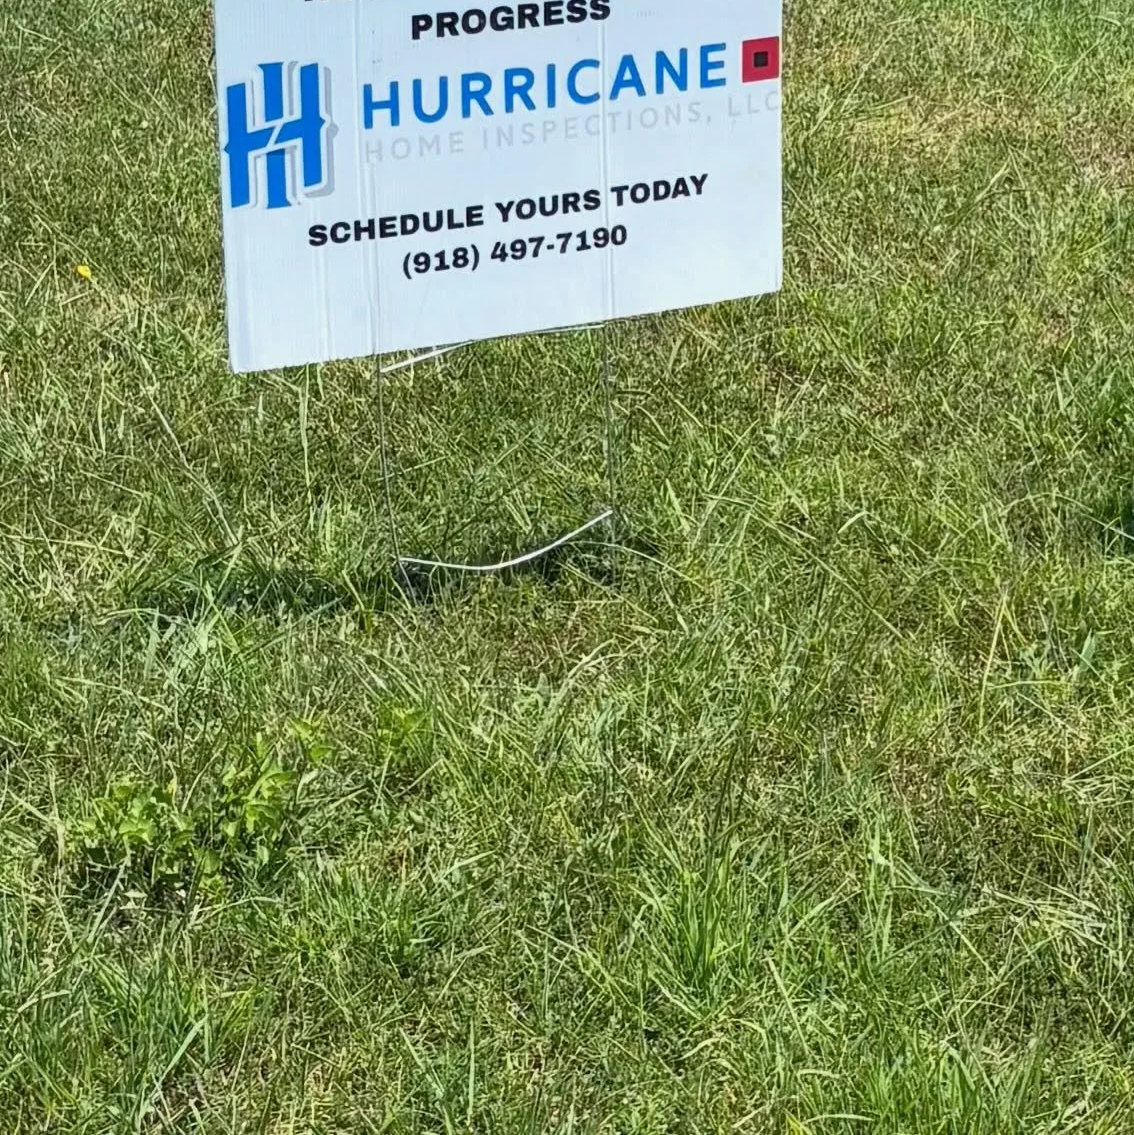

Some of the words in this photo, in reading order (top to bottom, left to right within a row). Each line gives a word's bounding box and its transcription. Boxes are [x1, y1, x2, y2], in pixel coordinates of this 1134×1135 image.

[362, 42, 727, 130] HURRICANE
[364, 130, 465, 164] HOME
[481, 101, 712, 152] INSPECTIONS,
[727, 90, 779, 117] LLC
[307, 205, 485, 247] SCHEDULE
[495, 188, 602, 224] YOURS
[610, 173, 709, 206] TODAY
[402, 244, 480, 280] (918)
[489, 224, 628, 263] 497-7190
